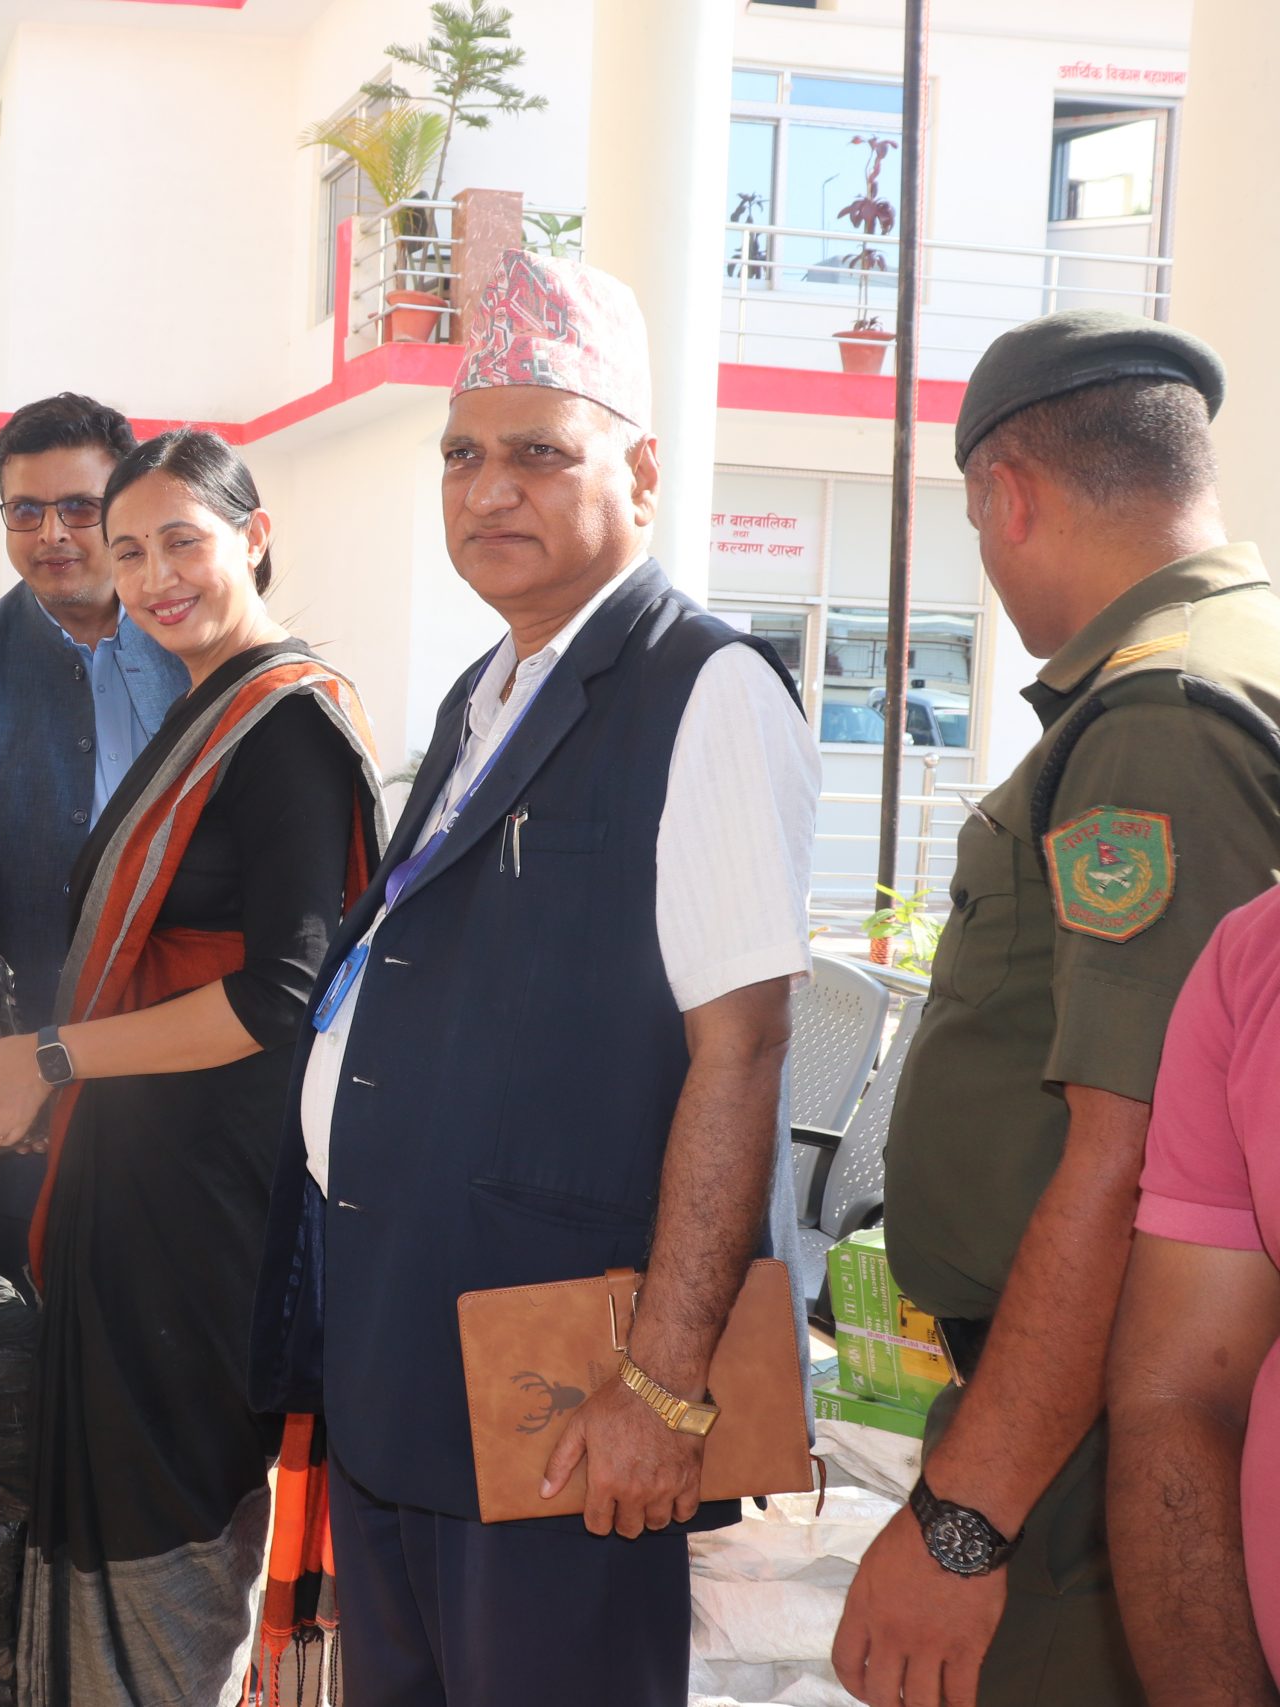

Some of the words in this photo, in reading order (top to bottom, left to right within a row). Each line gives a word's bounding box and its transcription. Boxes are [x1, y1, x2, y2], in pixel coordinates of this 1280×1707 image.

[861, 1254, 869, 1281] Meas
[869, 1256, 880, 1299] Capacity
[878, 1257, 890, 1313] Description
